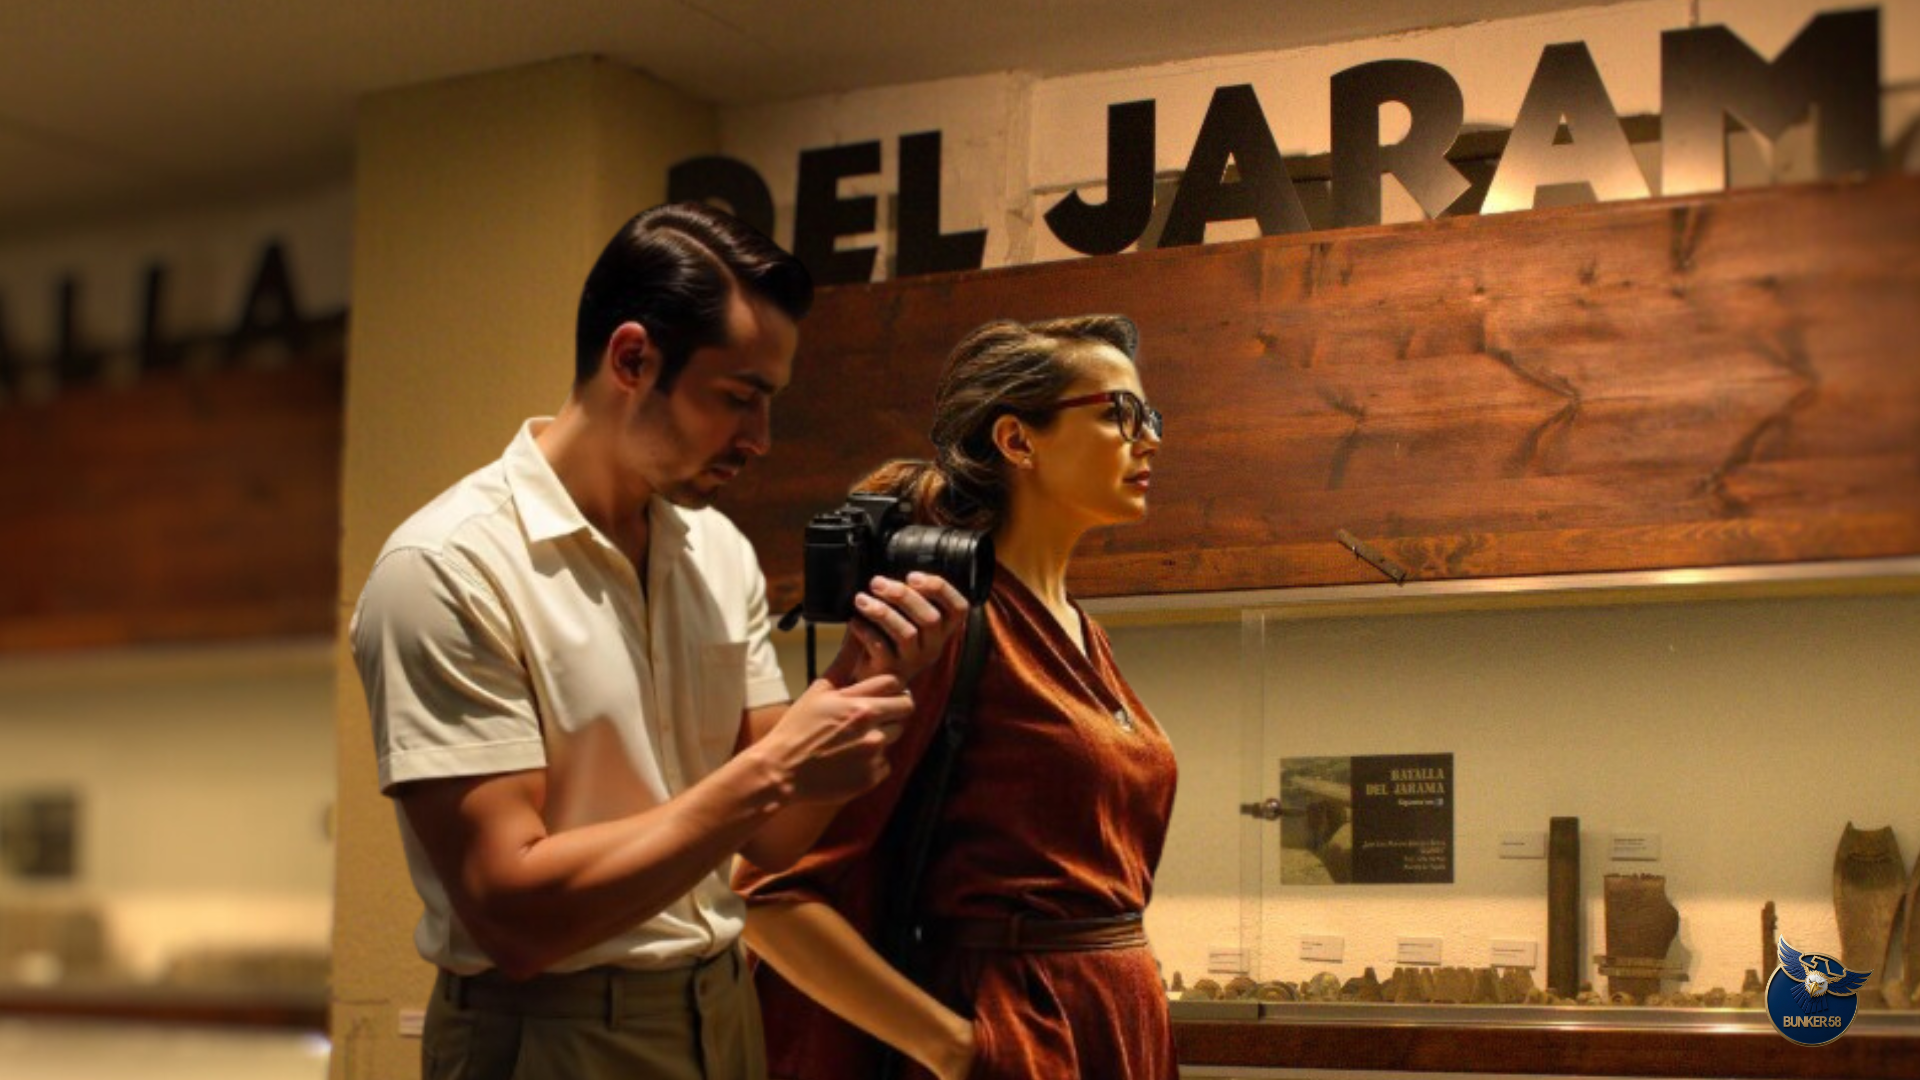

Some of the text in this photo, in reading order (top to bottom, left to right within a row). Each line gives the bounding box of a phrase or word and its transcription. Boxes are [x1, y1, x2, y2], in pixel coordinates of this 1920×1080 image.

[1043, 7, 1880, 258] JARAM
[0, 243, 304, 384] LLA
[1366, 783, 1444, 796] DEL JARAMA
[1391, 768, 1444, 780] BATALLA
